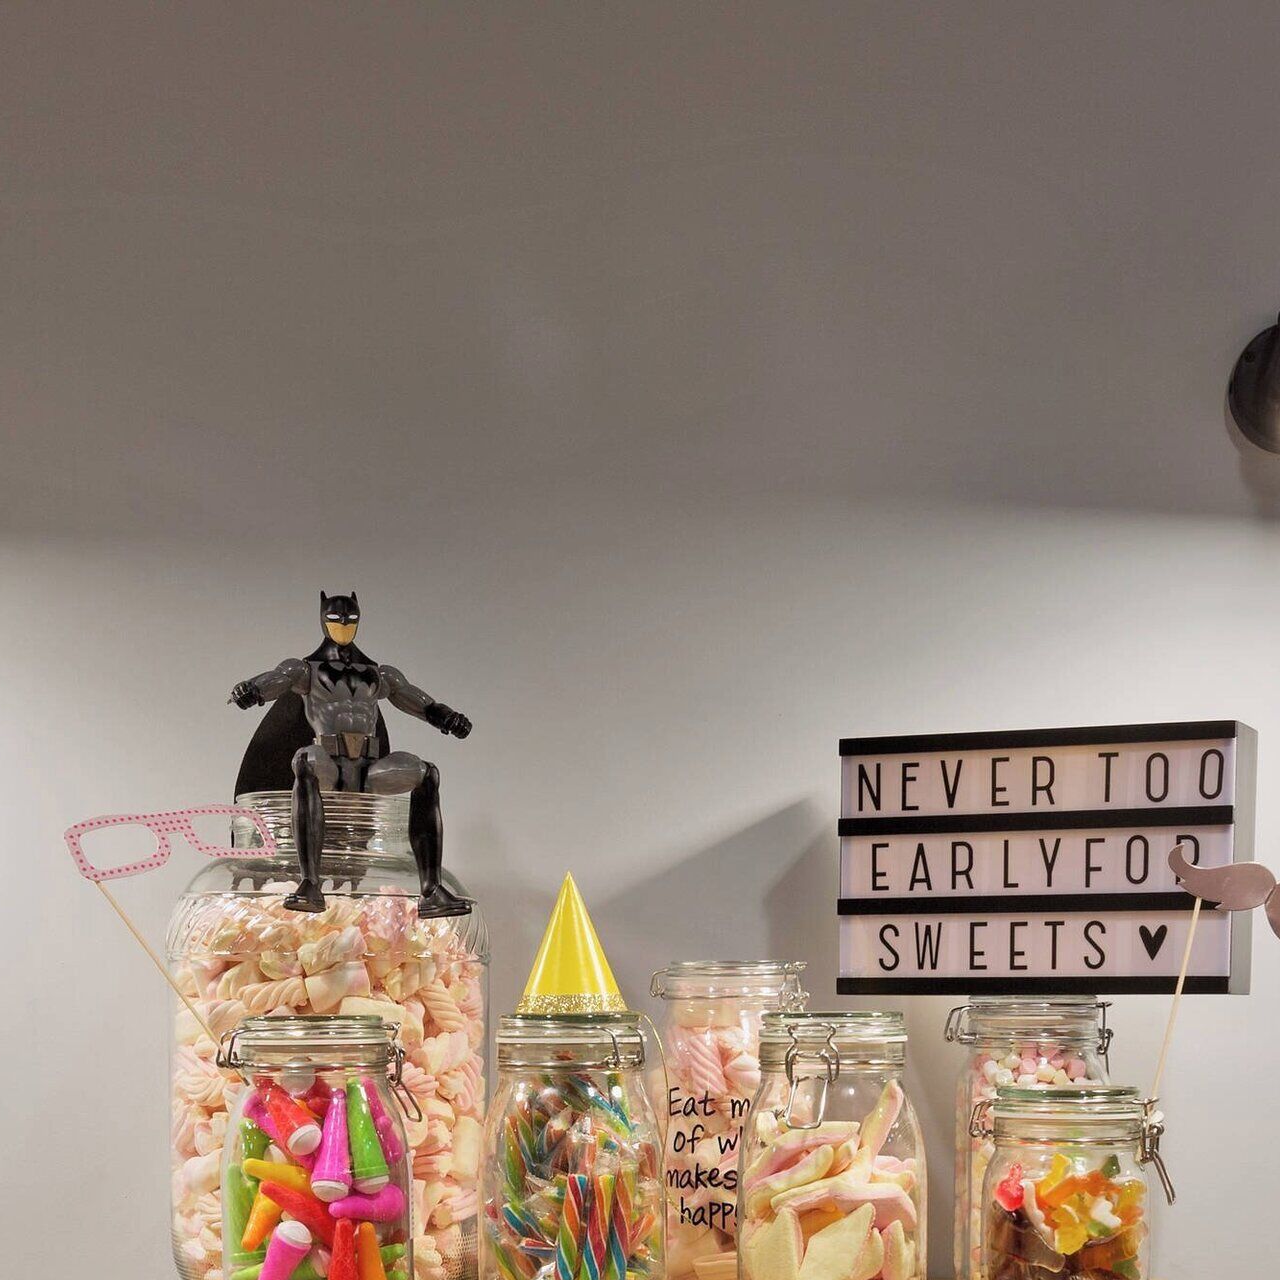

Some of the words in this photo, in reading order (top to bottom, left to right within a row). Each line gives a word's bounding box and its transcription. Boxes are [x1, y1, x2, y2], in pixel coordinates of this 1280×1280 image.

[857, 756, 1056, 812] NEVER
[1098, 748, 1225, 803] TOO
[878, 920, 1107, 972] SWEETS
[669, 1087, 716, 1117] Eat
[673, 1124, 705, 1153] of
[666, 1163, 738, 1190] makes
